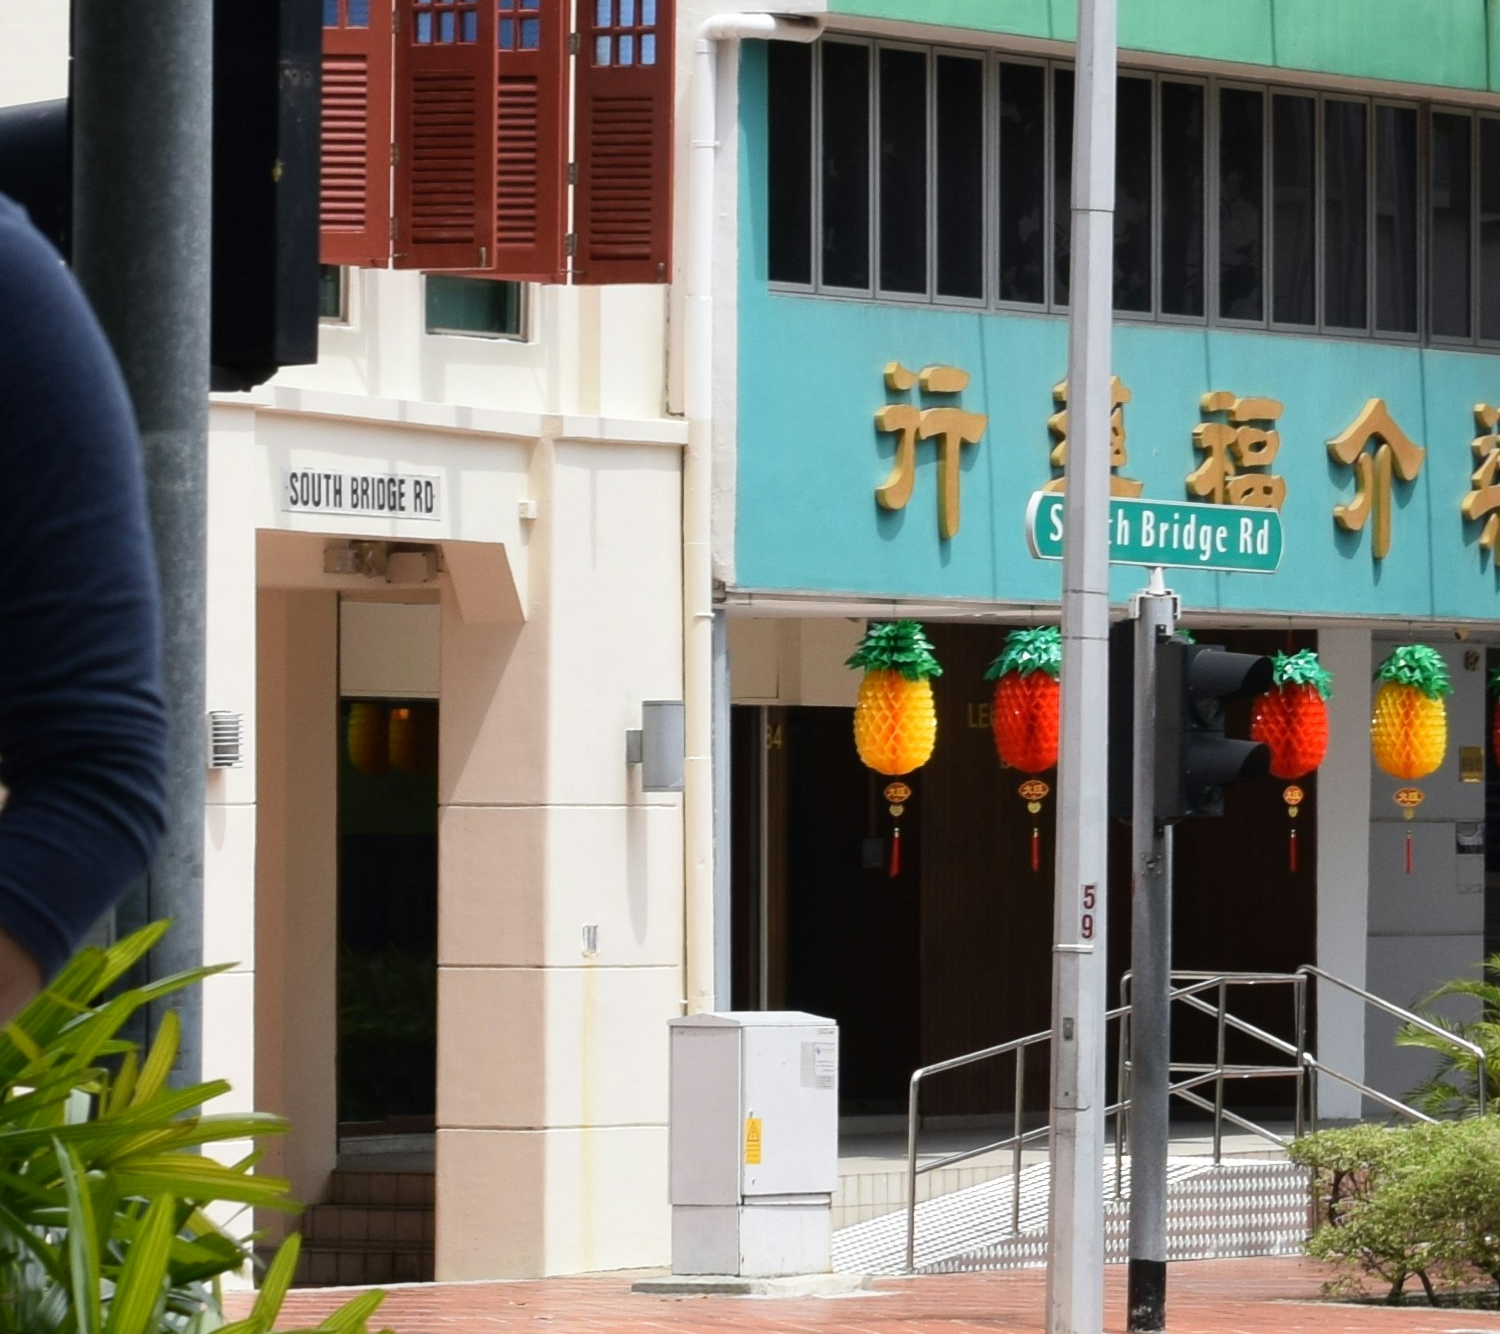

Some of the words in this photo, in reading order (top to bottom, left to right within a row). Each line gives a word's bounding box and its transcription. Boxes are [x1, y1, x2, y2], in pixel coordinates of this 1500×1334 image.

[289, 471, 343, 508] SOUTH
[350, 476, 406, 512] BRIDGE
[413, 479, 434, 514] RD
[1141, 509, 1229, 561] Bridge
[1239, 517, 1270, 556] Rd
[1081, 884, 1096, 939] 59
